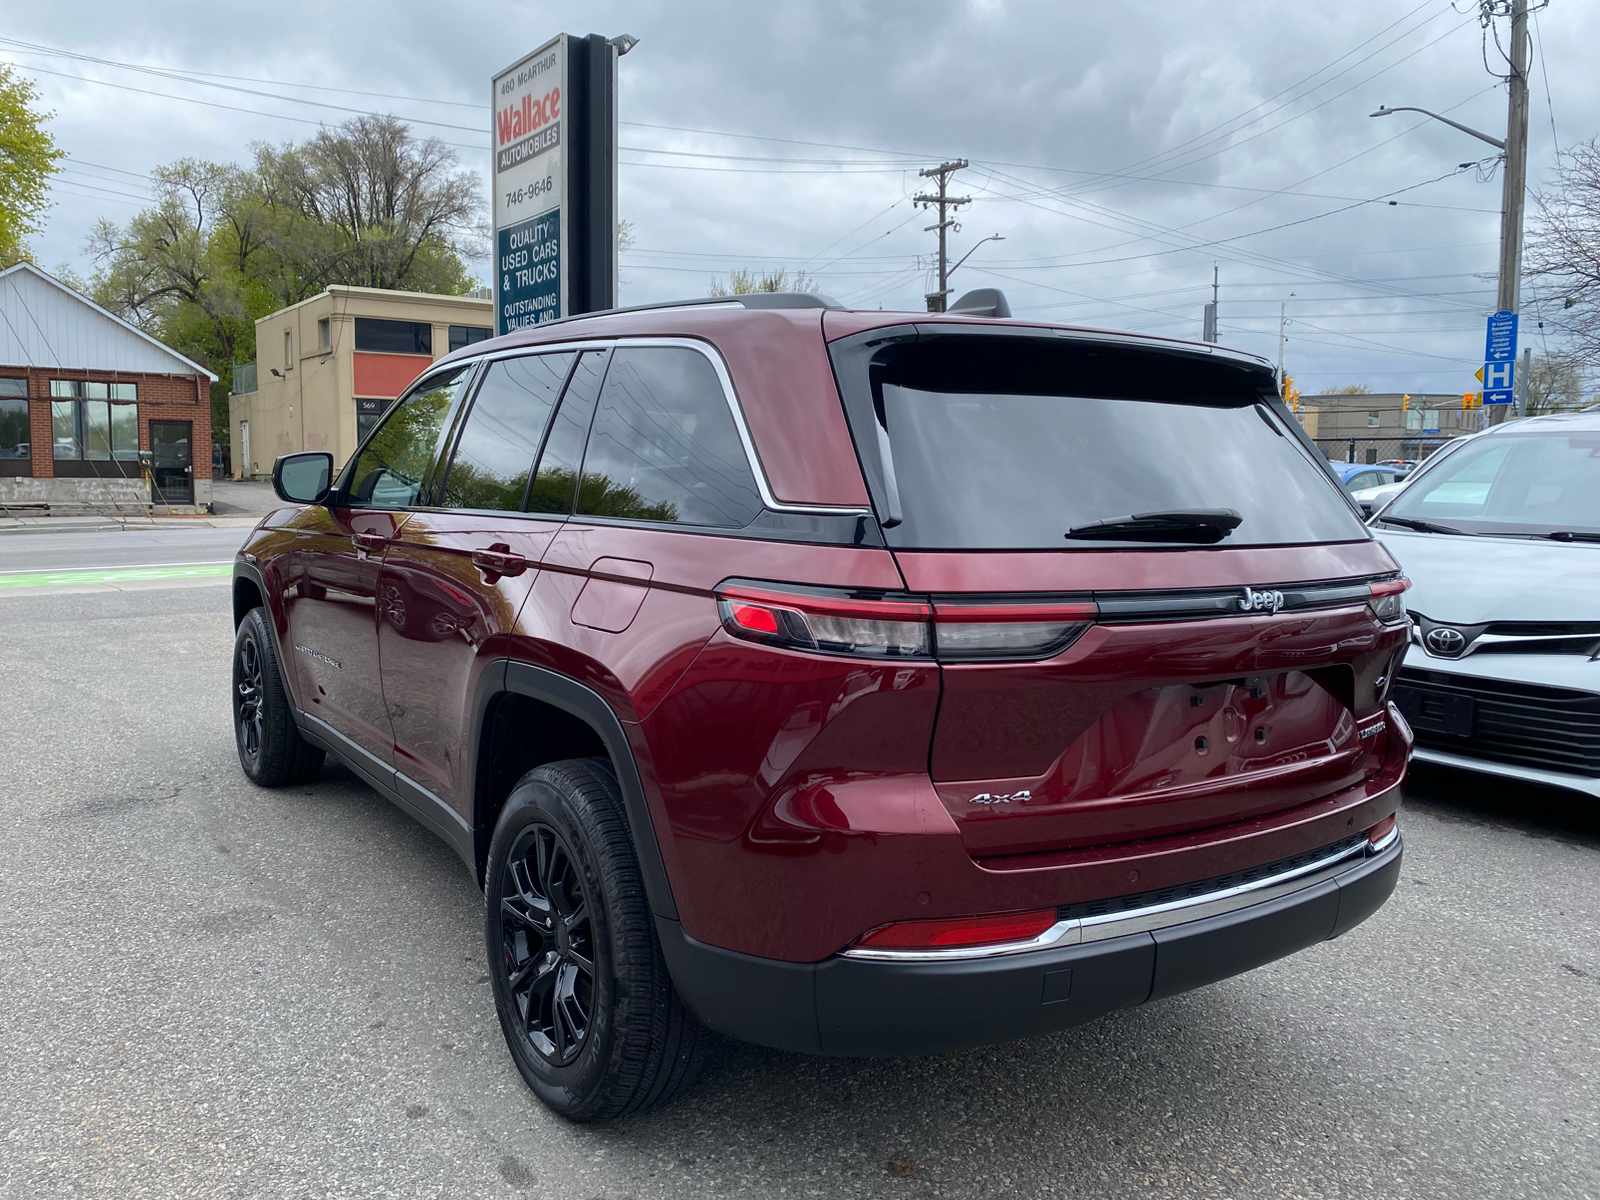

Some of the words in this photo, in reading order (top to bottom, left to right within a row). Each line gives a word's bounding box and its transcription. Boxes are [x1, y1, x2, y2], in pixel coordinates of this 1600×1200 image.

[501, 78, 515, 95] 460
[518, 52, 556, 87] McARTHUR
[496, 87, 560, 146] Wallace
[501, 126, 558, 168] AUTOMOBILES
[506, 175, 553, 208] 746-9646
[510, 221, 550, 250] QUALITY
[502, 251, 528, 271] USED
[532, 239, 558, 263] CARS
[503, 274, 511, 291] &
[515, 260, 557, 289] TRUCKS
[504, 292, 557, 317] OUTSTANDING
[506, 314, 535, 331] VALUES
[539, 309, 555, 324] AND
[1488, 363, 1510, 388] H
[1238, 586, 1284, 613] Jeep
